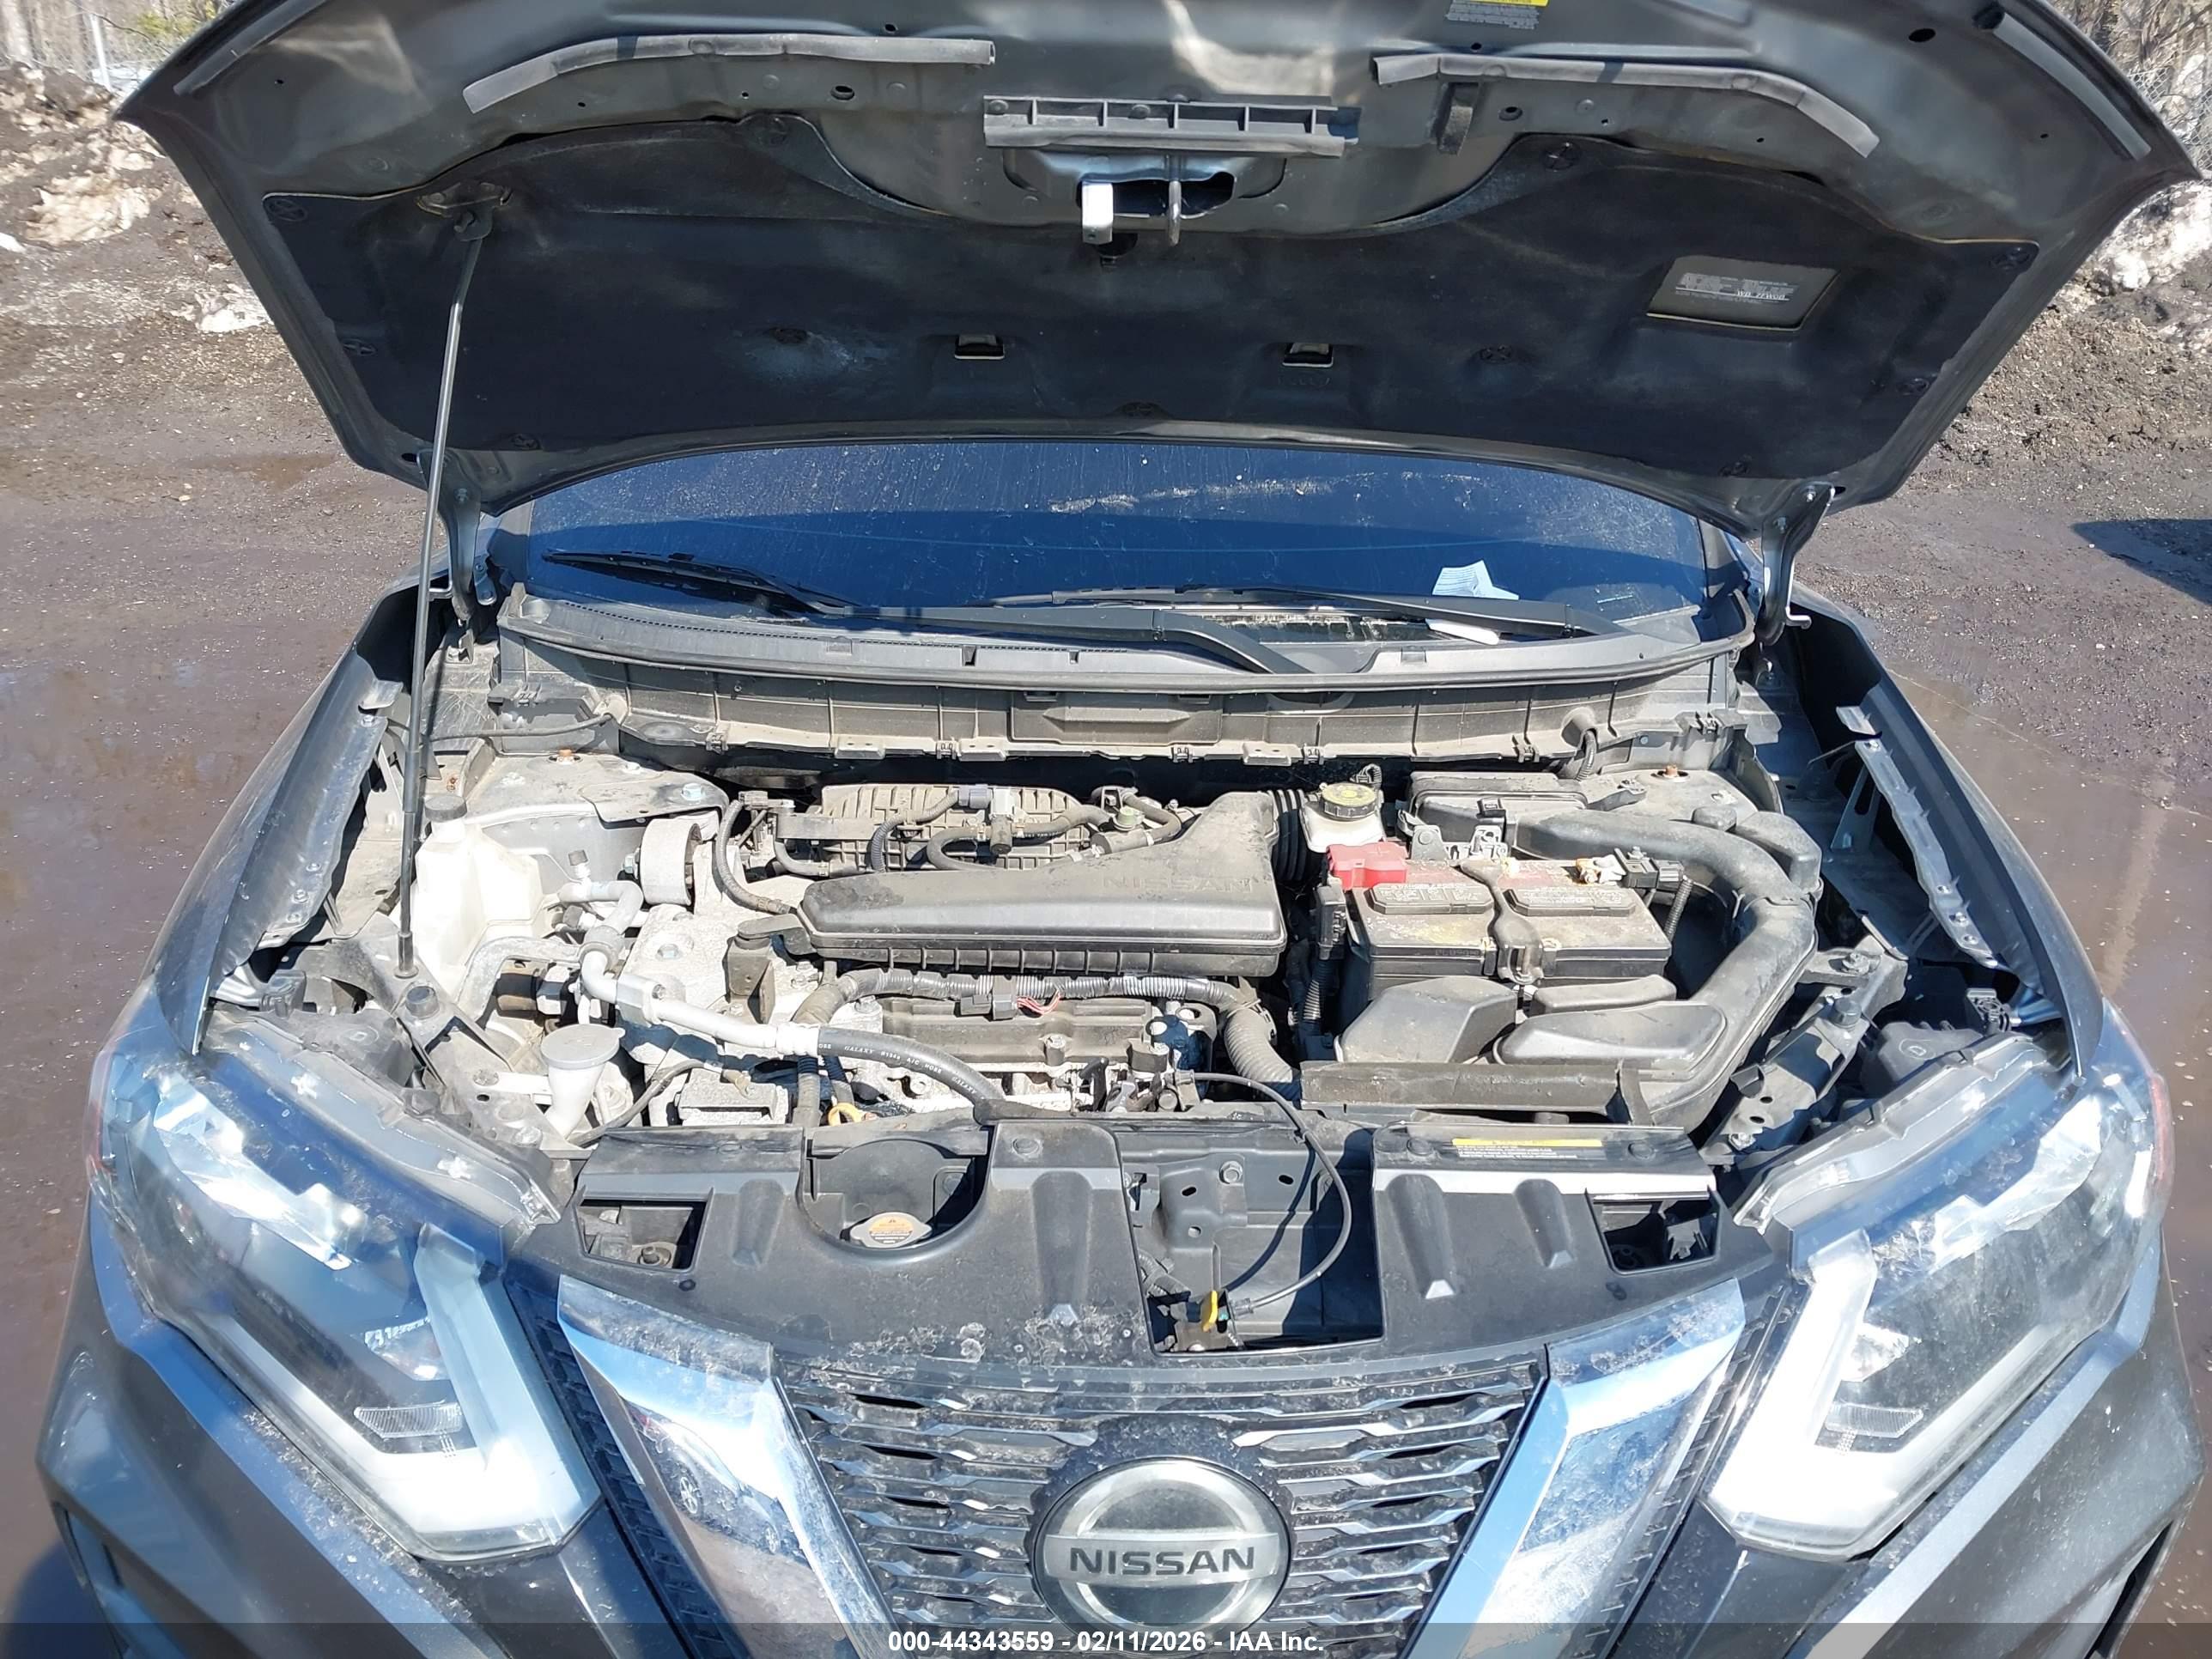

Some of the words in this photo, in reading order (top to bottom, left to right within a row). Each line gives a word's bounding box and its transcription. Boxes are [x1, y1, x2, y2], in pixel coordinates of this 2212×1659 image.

[1103, 876, 1253, 894] NISSAN
[844, 1045, 875, 1054] GALAXY
[951, 1076, 978, 1095] GALAXY
[1070, 1547, 1255, 1576] NISSAN
